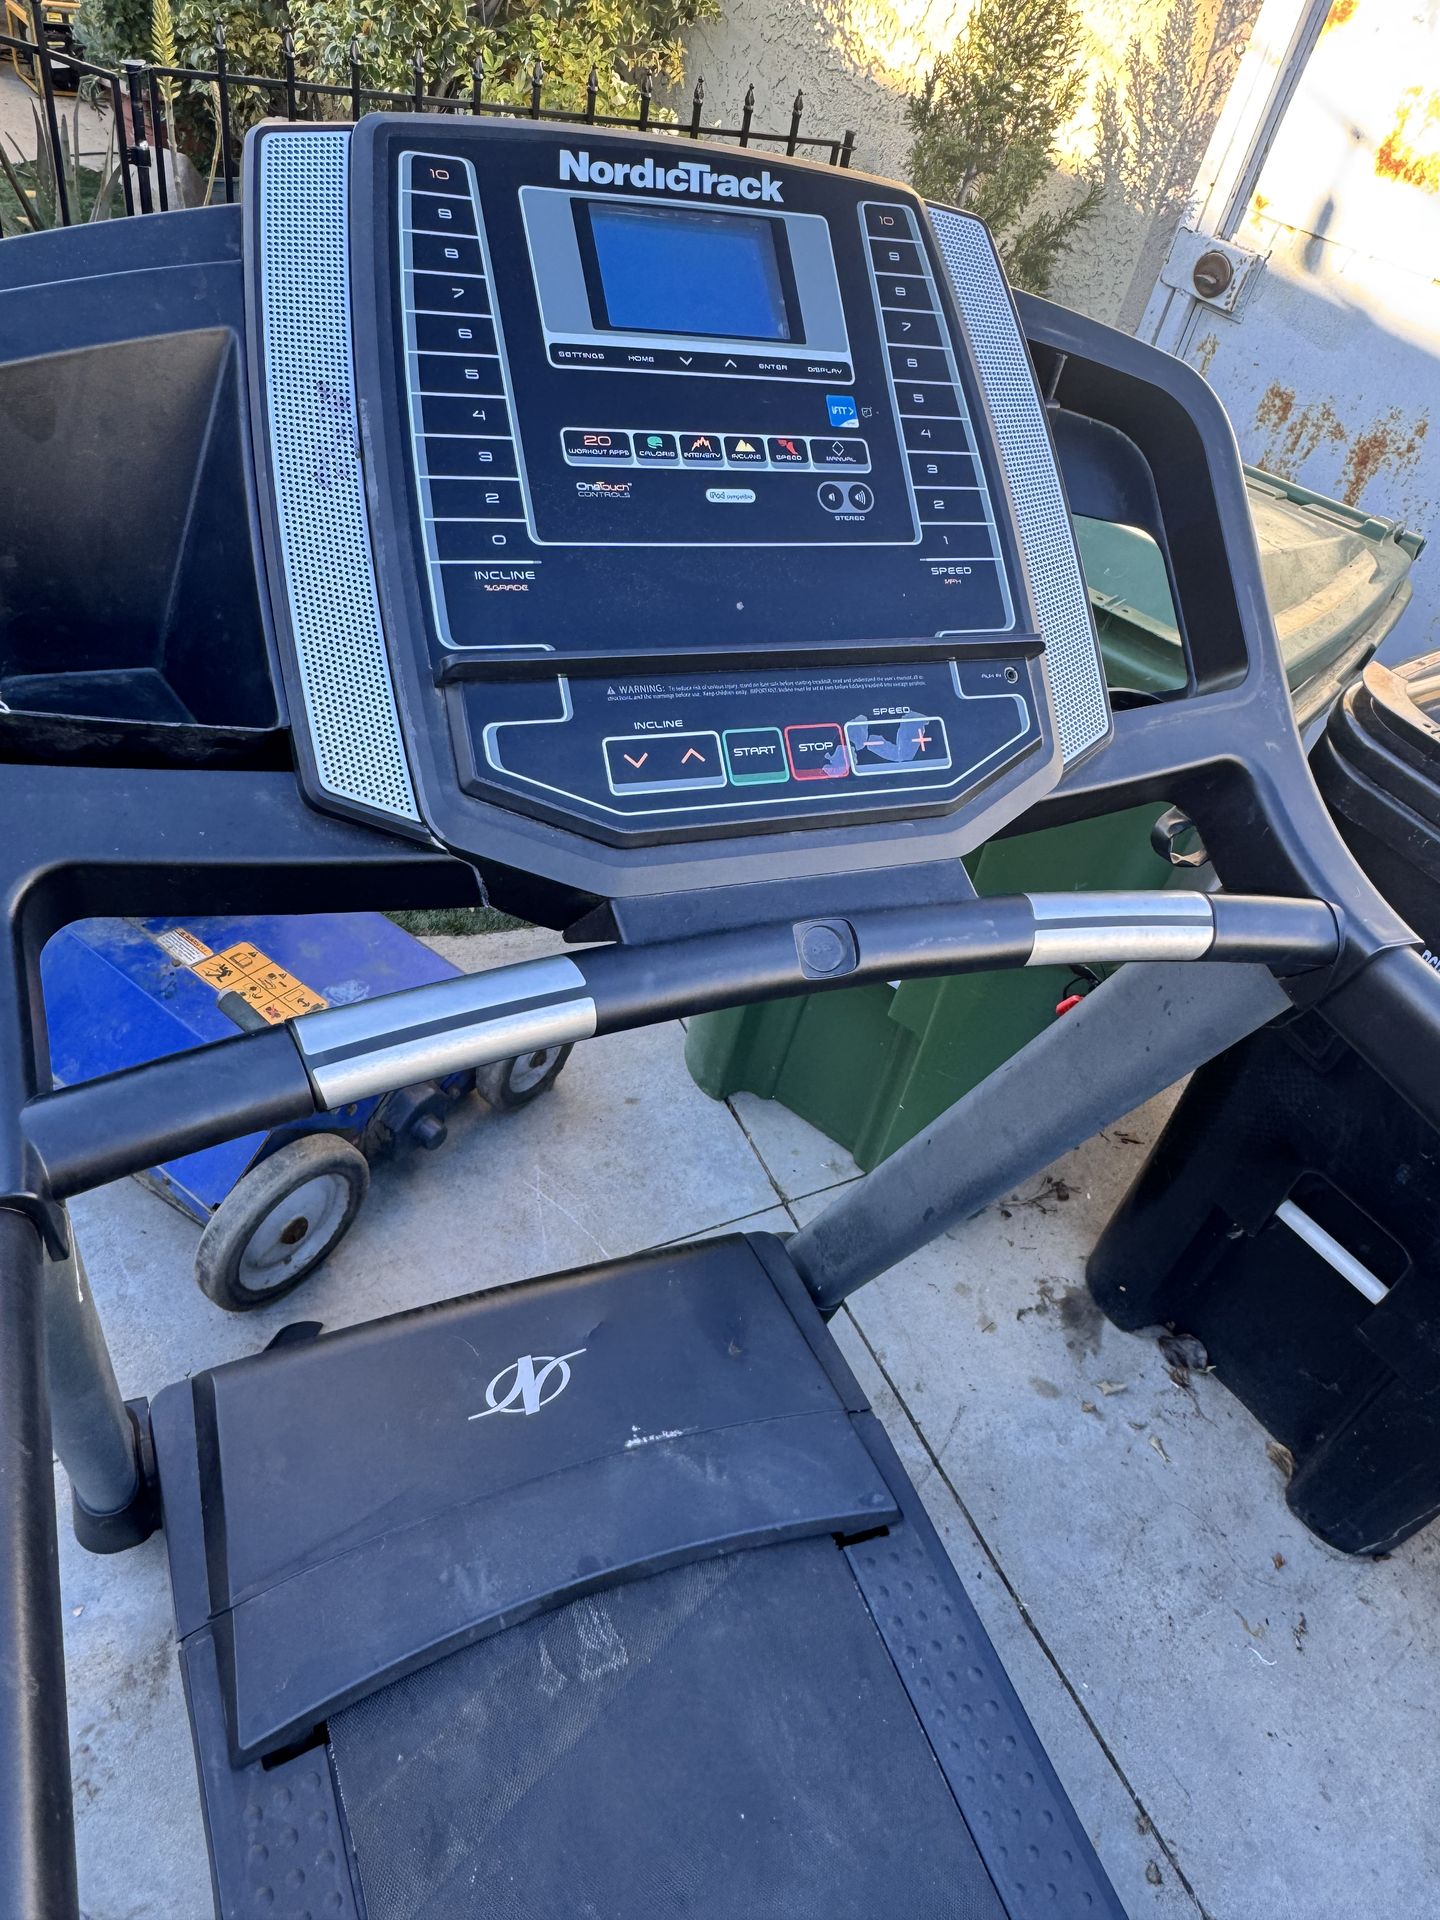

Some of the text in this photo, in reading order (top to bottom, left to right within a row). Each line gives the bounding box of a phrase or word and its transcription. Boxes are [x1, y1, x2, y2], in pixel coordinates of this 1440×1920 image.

[429, 168, 450, 180] 10
[559, 149, 784, 203] NordicTrack
[437, 208, 453, 219] 9
[879, 215, 895, 226] 10
[444, 248, 459, 259] 8
[888, 251, 900, 261] 9
[451, 288, 465, 299] 7
[894, 286, 907, 296] 8
[901, 322, 912, 332] 7
[458, 328, 473, 339] 6
[627, 355, 655, 363] HOME
[906, 358, 918, 368] 6
[758, 363, 788, 371] ENTER
[807, 366, 843, 375] DISPLAY
[464, 368, 480, 380] 5
[912, 393, 925, 403] 5
[472, 410, 486, 421] 4
[920, 428, 932, 438] 4
[583, 435, 612, 446] 20
[568, 447, 608, 455] WORKOUT
[478, 451, 493, 462] 3
[825, 455, 857, 463] MANUAL
[926, 464, 938, 474] 3
[485, 493, 500, 504] 2
[933, 500, 945, 510] 2
[491, 534, 507, 546] 0
[474, 570, 536, 580] INCLINE
[930, 566, 972, 576] SPEED
[618, 684, 666, 694] WARNING:
[872, 706, 911, 716] SPEED
[633, 719, 684, 730] INCLINE
[733, 745, 776, 757] START
[798, 741, 833, 752] STOP
